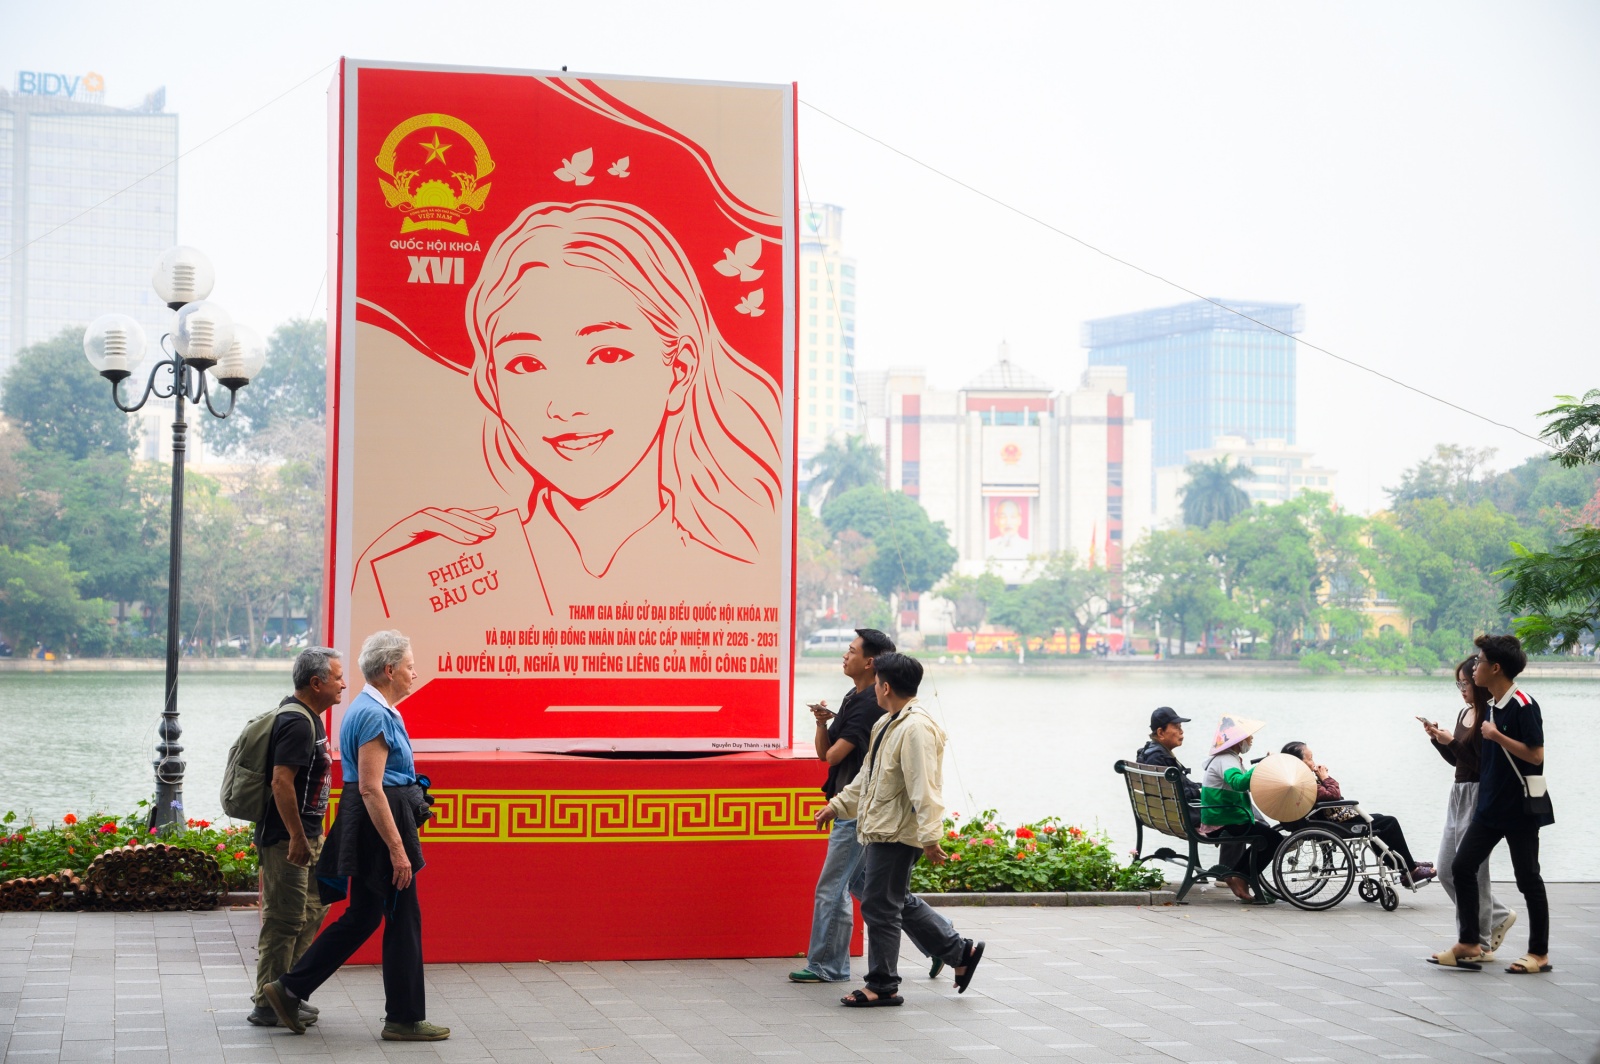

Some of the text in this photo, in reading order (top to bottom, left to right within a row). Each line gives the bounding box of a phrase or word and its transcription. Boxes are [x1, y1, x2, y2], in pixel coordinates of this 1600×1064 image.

[19, 71, 80, 97] BIDV
[390, 237, 481, 252] QUỐC HỘI KHOÁ
[407, 256, 464, 284] XVI
[428, 552, 484, 587] PHIẾU
[429, 570, 499, 613] BẦU CỬ
[569, 600, 778, 624] THAM GIA BẦU CỬ ĐẠI BIỂU QUỐC HỘI KHÓA XVI
[486, 628, 498, 646] VÀ
[500, 630, 516, 648] ĐẠI
[518, 624, 540, 646] BIỂU
[542, 628, 557, 648] HỘI
[560, 626, 586, 646] ĐỒNG
[588, 628, 614, 646] NHÂN
[616, 628, 636, 646] DÂN
[638, 628, 656, 646] CÁC
[660, 626, 678, 646] CẤP
[680, 629, 710, 649] NHIỆM
[713, 629, 724, 646] KỲ
[726, 632, 748, 646] 2026
[758, 632, 778, 647] 2031
[438, 650, 778, 676] LÀ QUYỀN LỢI, NGHĨA VỤ THIÊNG LIÊNG CỦA MỖI CÔNG DÂN!
